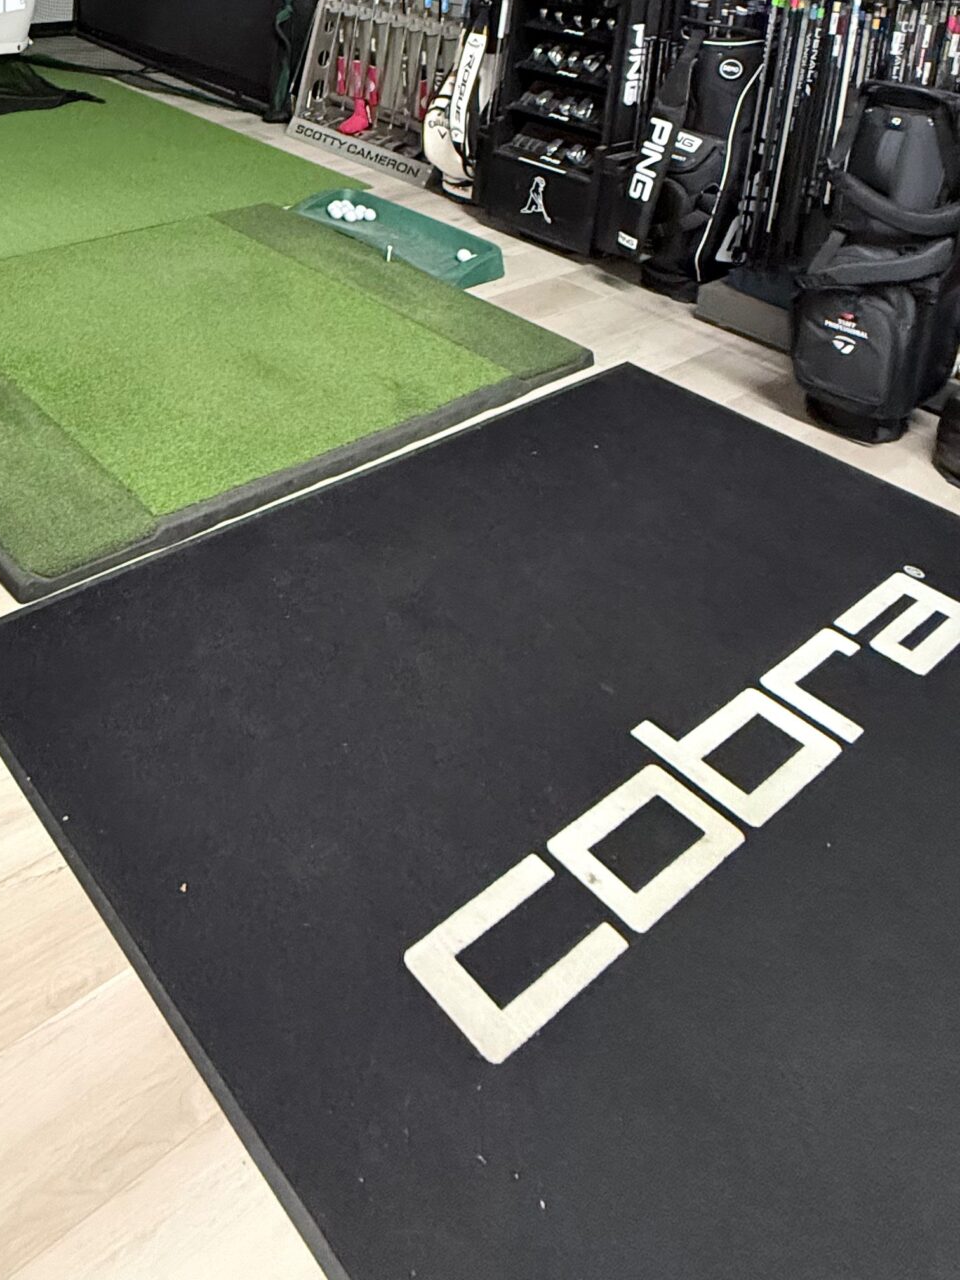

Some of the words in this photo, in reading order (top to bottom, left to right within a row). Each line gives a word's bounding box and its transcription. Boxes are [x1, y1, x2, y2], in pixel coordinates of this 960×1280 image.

[295, 124, 347, 149] SCOTTY
[346, 143, 421, 178] CAMERON
[628, 116, 673, 203] PING
[403, 571, 960, 1065] cobra
